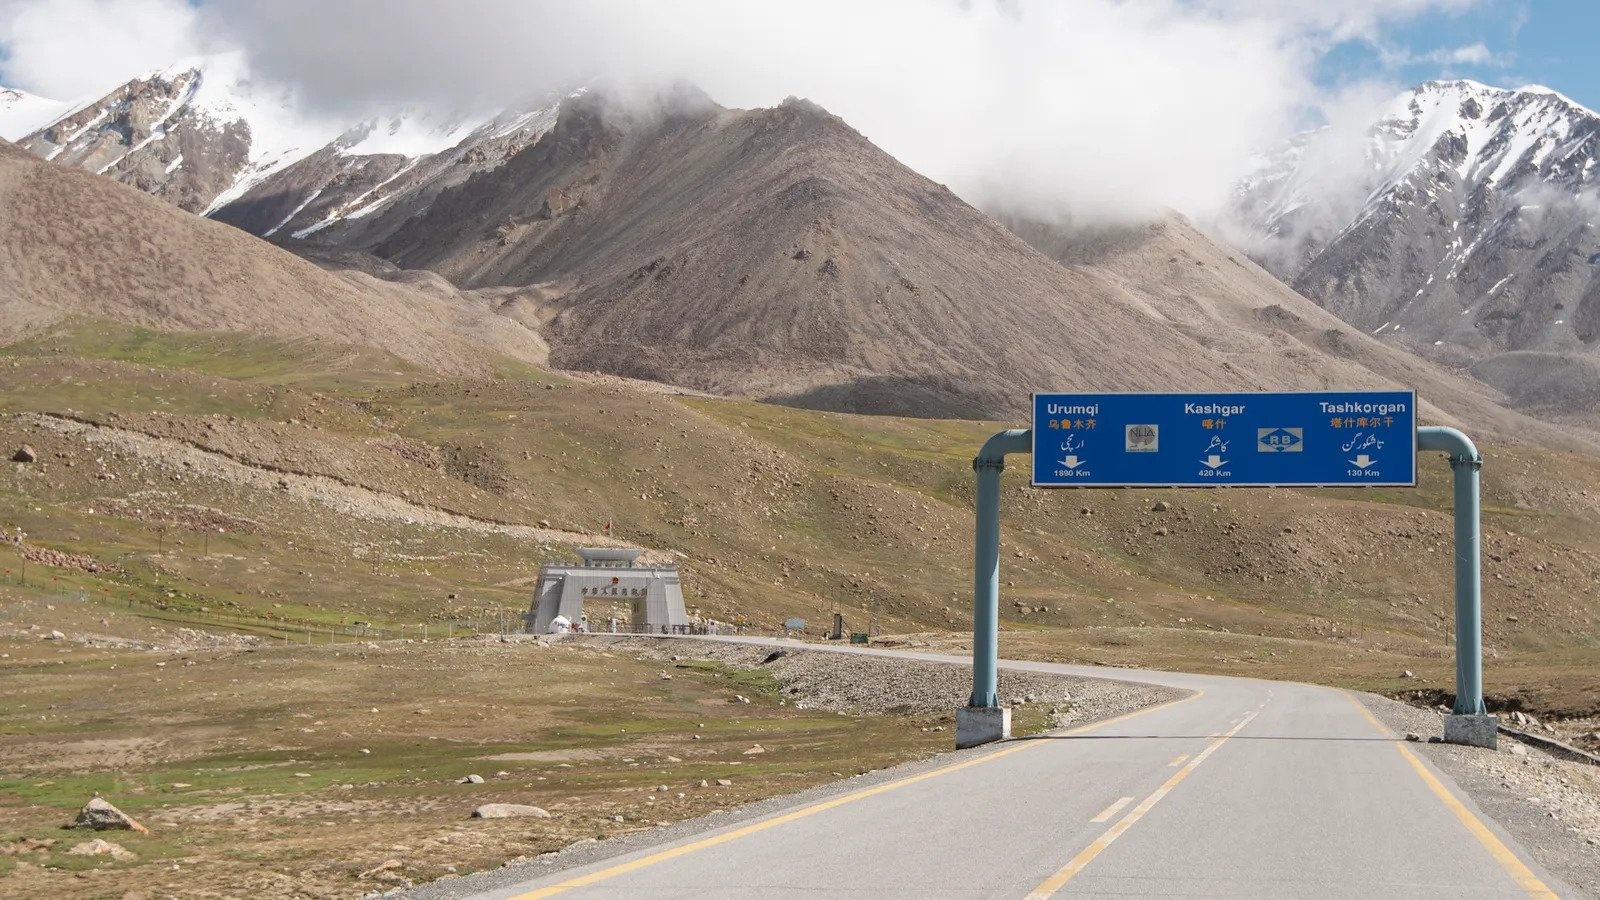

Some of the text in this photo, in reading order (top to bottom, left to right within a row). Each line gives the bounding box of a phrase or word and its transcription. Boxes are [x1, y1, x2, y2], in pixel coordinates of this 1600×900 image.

[1047, 403, 1099, 416] Urumqi
[1184, 403, 1246, 416] Kashgar
[1319, 402, 1406, 415] Tashkorgan
[1048, 418, 1097, 430] 乌鲁木齐
[1201, 418, 1227, 430] 喀什
[1054, 469, 1091, 477] 1890 Km
[1198, 469, 1231, 477] 420 Km
[1346, 469, 1380, 477] 130 Km
